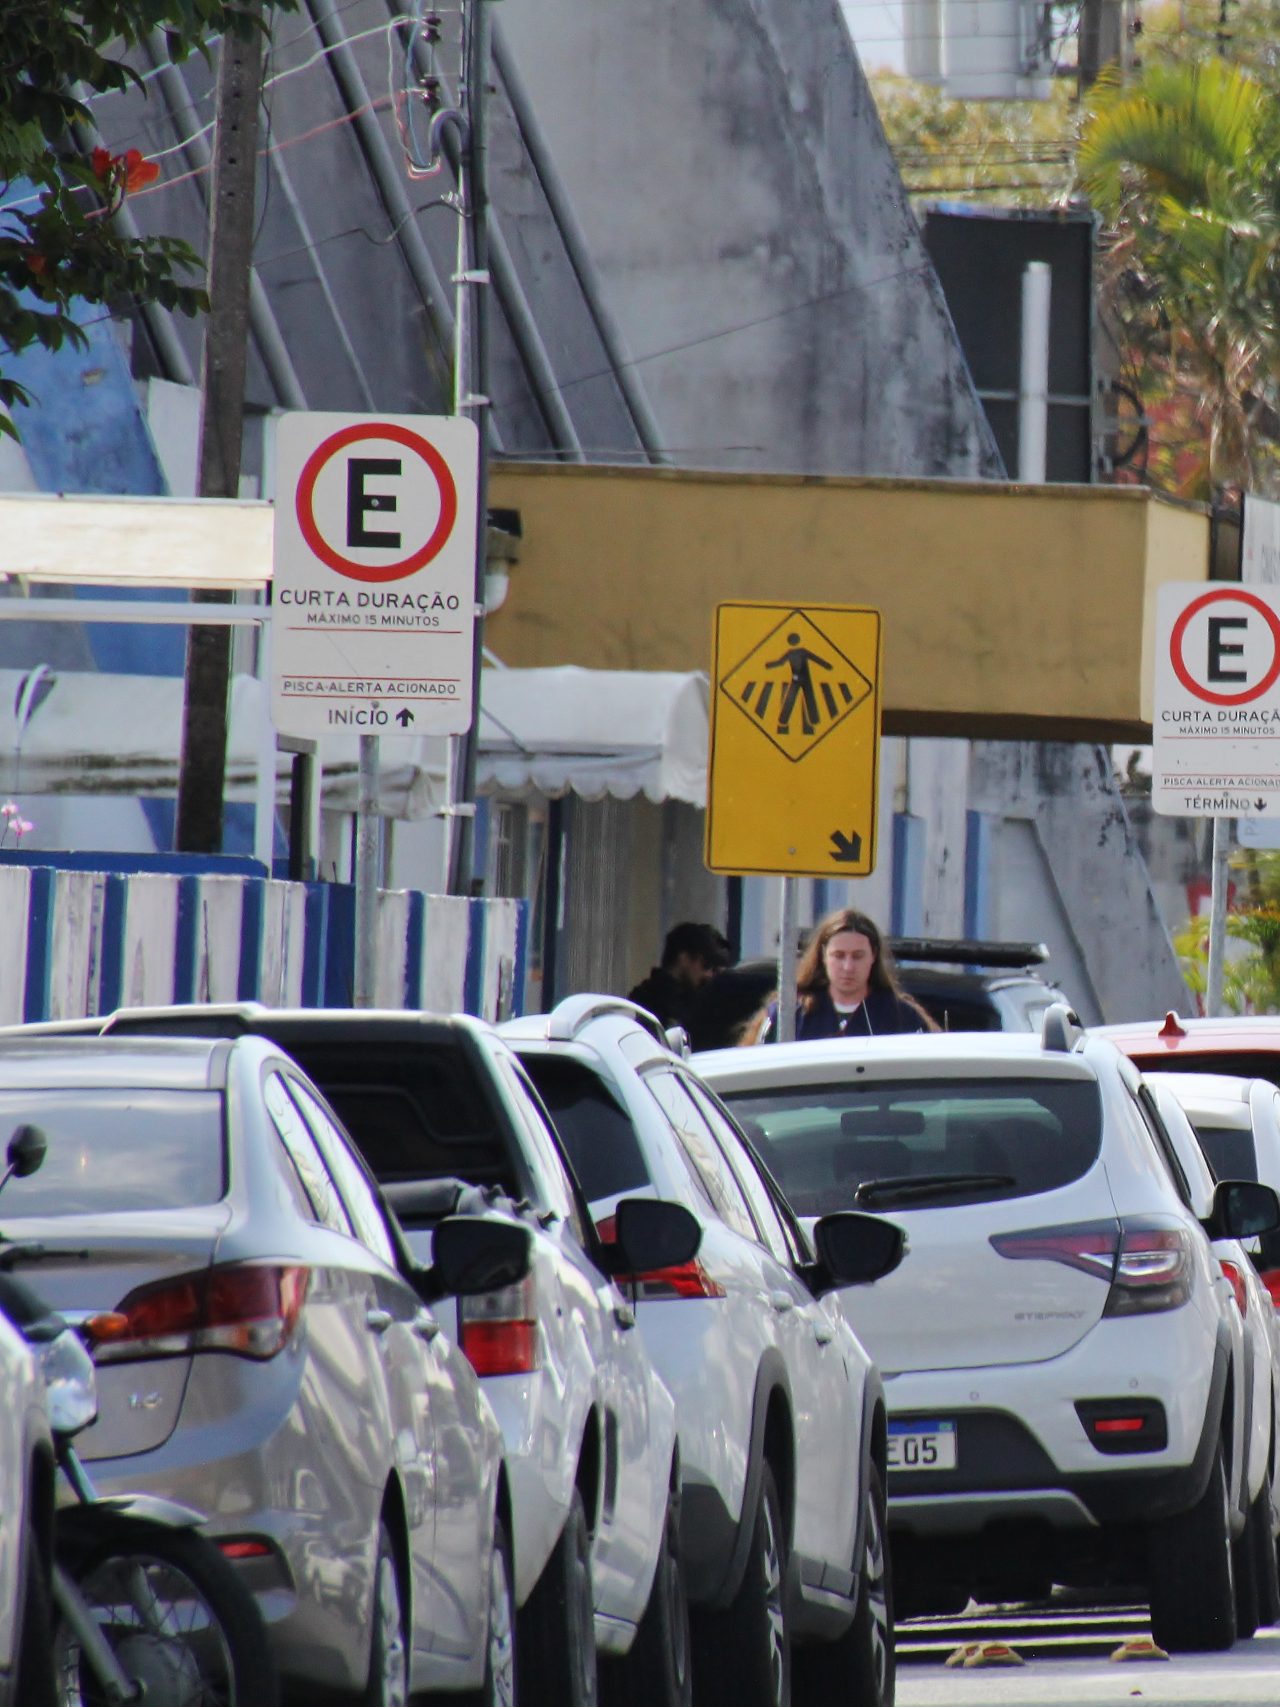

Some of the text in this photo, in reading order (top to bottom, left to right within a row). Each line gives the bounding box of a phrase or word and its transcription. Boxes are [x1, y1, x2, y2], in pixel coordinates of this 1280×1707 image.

[347, 458, 402, 548] E
[280, 590, 460, 613] CURTA DURAÇÃO
[307, 611, 440, 627] MÁXIMO 15 MINUTOS
[1207, 617, 1248, 683] E
[283, 681, 457, 695] PISCA-ALERTA ACIONADO
[328, 705, 389, 726] INÍCIO
[1161, 711, 1212, 723] CURTA
[1179, 725, 1276, 736] MÁXIMO 15 MINUTOS
[1184, 795, 1250, 810] TÉRMINO
